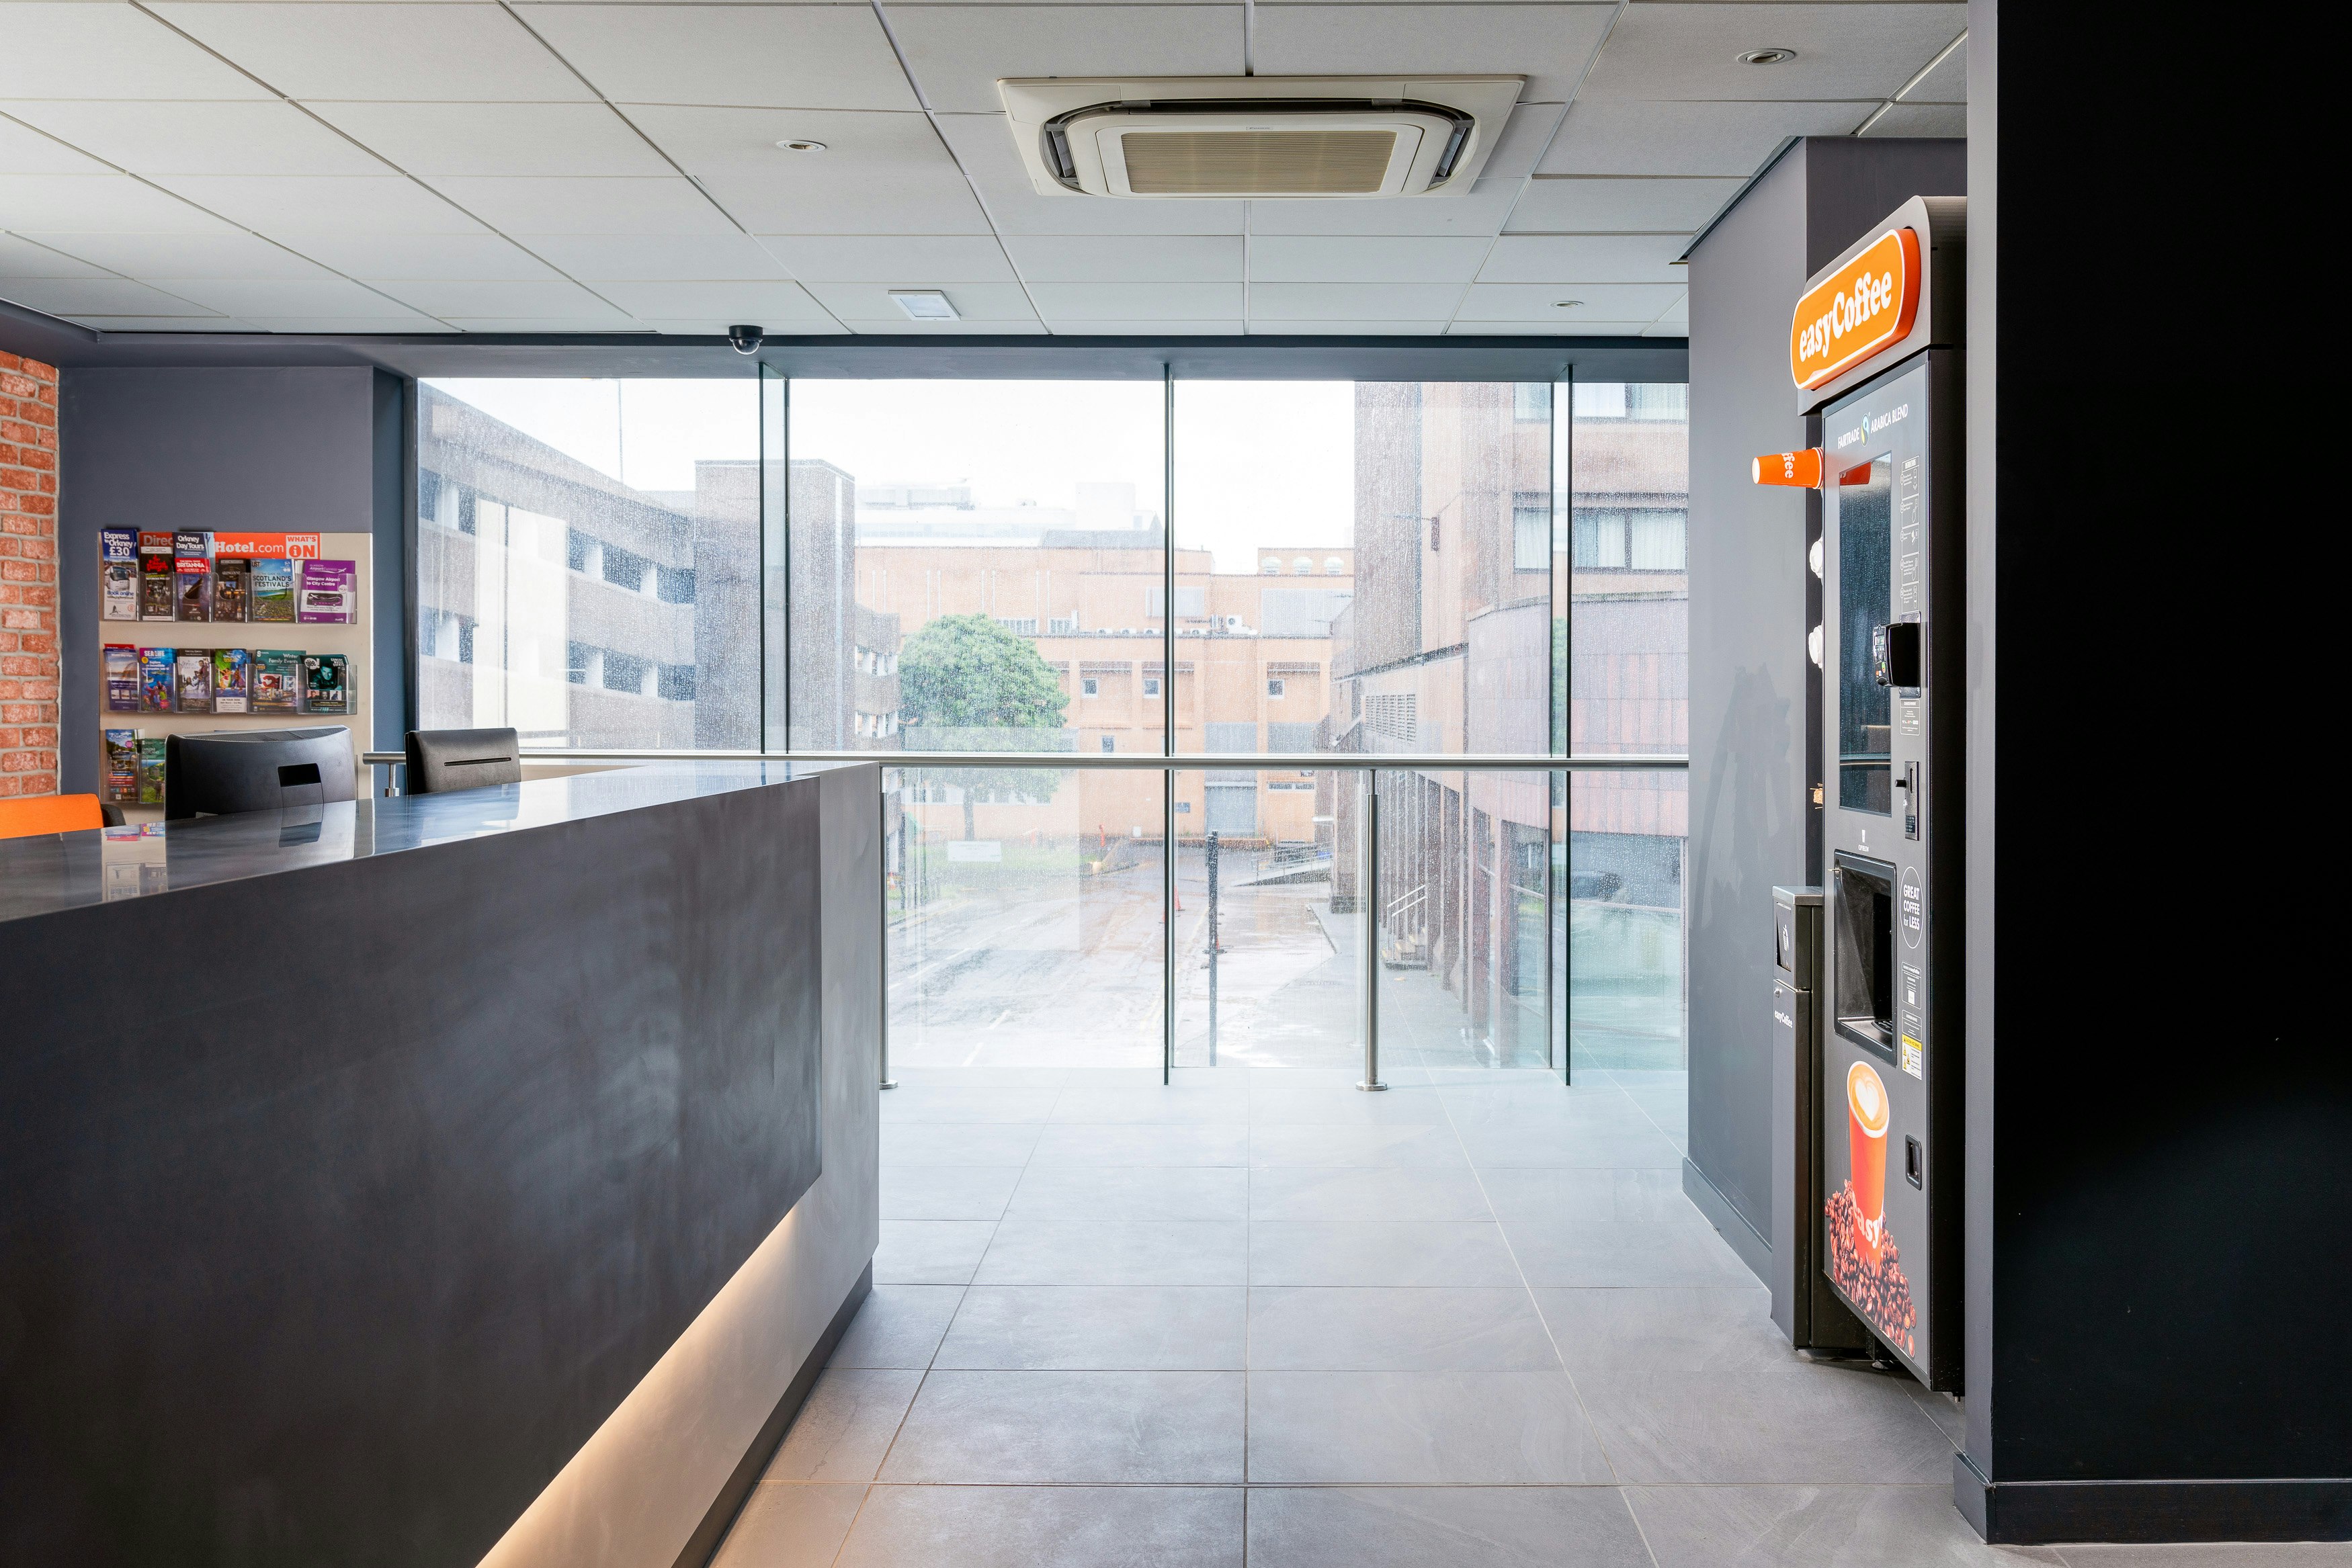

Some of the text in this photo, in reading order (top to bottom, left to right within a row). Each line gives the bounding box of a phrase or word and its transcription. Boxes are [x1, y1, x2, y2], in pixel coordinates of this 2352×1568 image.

[1800, 271, 1892, 362] easyCoffee
[1870, 403, 1908, 434] ARABICA BLEND
[1838, 427, 1859, 449] FAIRTRADE
[103, 531, 130, 540] Express
[109, 539, 133, 549] Orkney
[110, 547, 130, 557] £30
[1903, 884, 1920, 901] GREAT
[1903, 900, 1920, 916] COFFEE
[1908, 916, 1920, 930] LESS
[1775, 1010, 1793, 1029] easyCoffee
